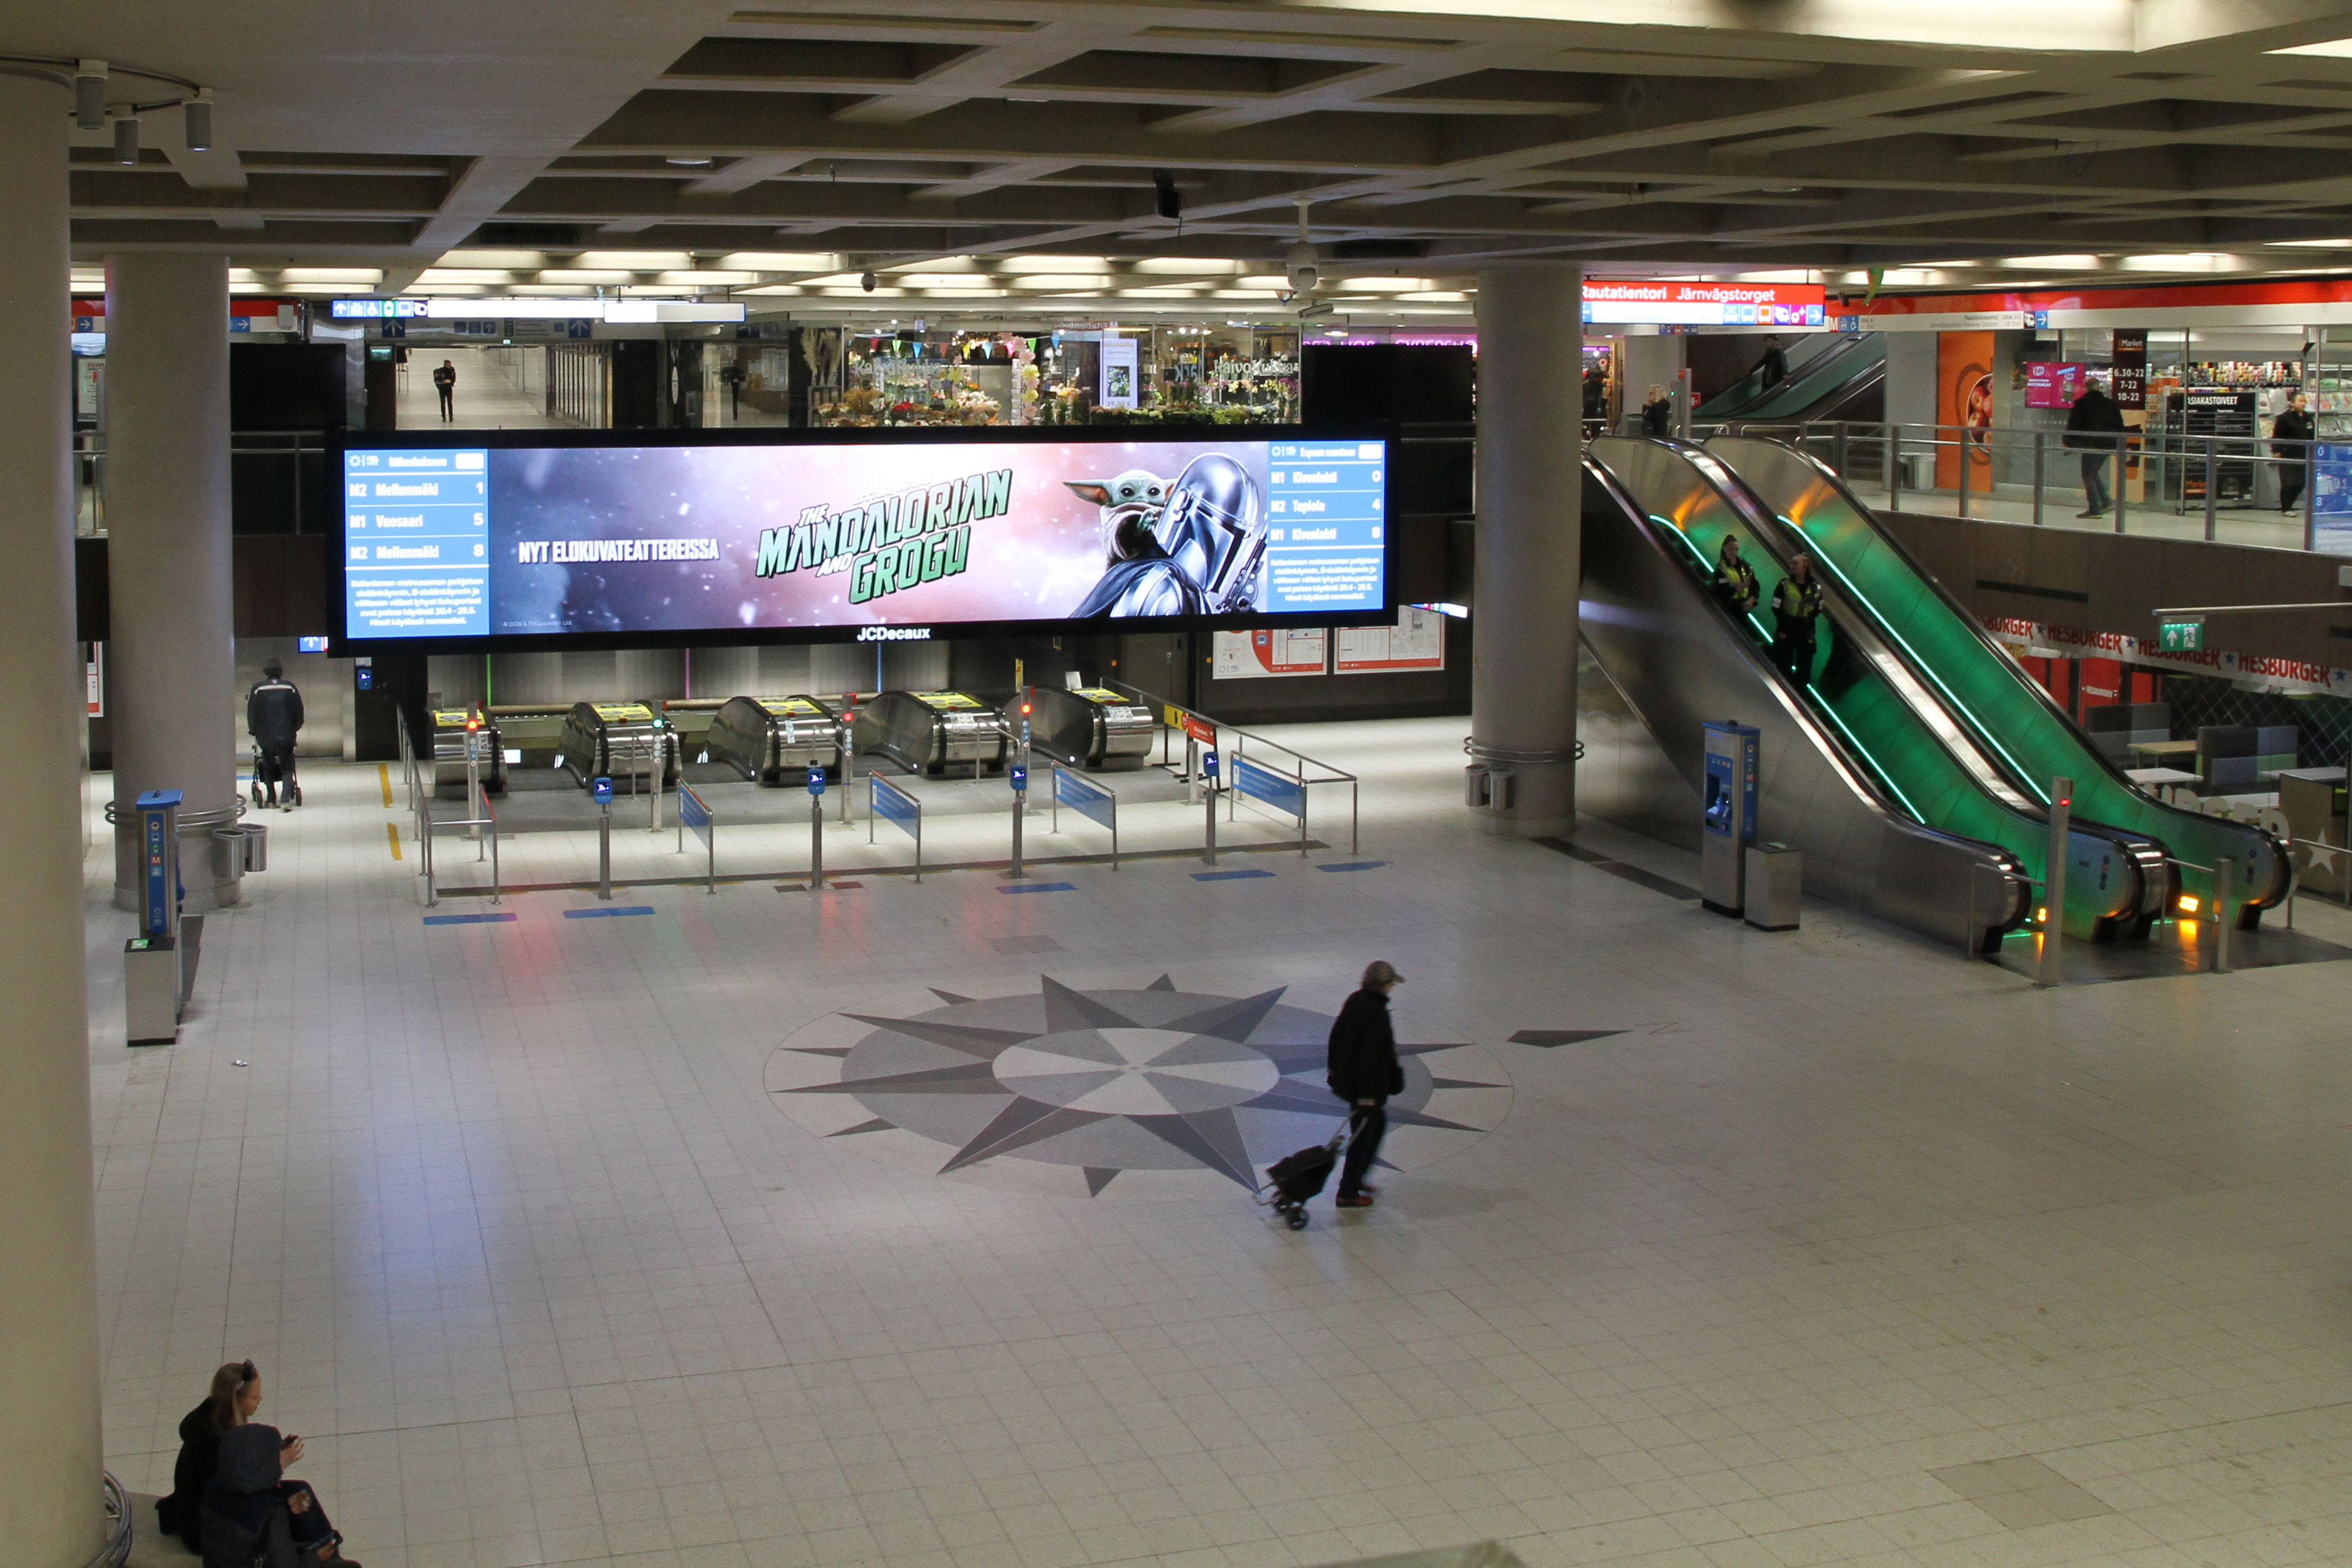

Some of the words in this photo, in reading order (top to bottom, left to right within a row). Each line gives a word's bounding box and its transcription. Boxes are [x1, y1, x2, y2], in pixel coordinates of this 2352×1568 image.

[1676, 287, 1775, 303] Järnvägstorget
[2114, 369, 2144, 377] 6.30-22
[2118, 393, 2140, 401] 10-22
[1271, 472, 1284, 484] M1
[1293, 471, 1338, 484] Kivenlahti
[1371, 470, 1381, 482] 0
[350, 484, 367, 497] M2
[376, 482, 438, 496] Mellunmäki
[476, 482, 483, 495] 1
[1270, 500, 1286, 513] M2
[1292, 499, 1325, 515] Tapiola
[1371, 499, 1381, 511] 4
[350, 515, 366, 528] M1
[376, 515, 423, 528] Vuosaari
[473, 513, 484, 525] 5
[756, 469, 1013, 578] MANDALORIAN
[799, 504, 830, 527] THE
[1270, 529, 1284, 541] M1
[1292, 528, 1336, 541] Kivenlahti
[1371, 526, 1381, 538] 8
[350, 547, 368, 559] M2
[377, 545, 439, 559] Mellunmäki
[473, 544, 484, 557] 8
[518, 541, 550, 563] NYT
[552, 538, 720, 563] ELOKUVATEATTEREISSA
[815, 552, 854, 577] AND
[849, 525, 971, 605] GROGU
[856, 627, 931, 641] JCDecaux
[2048, 624, 2122, 654] HESBURGER
[2238, 652, 2331, 688] HESBURGER
